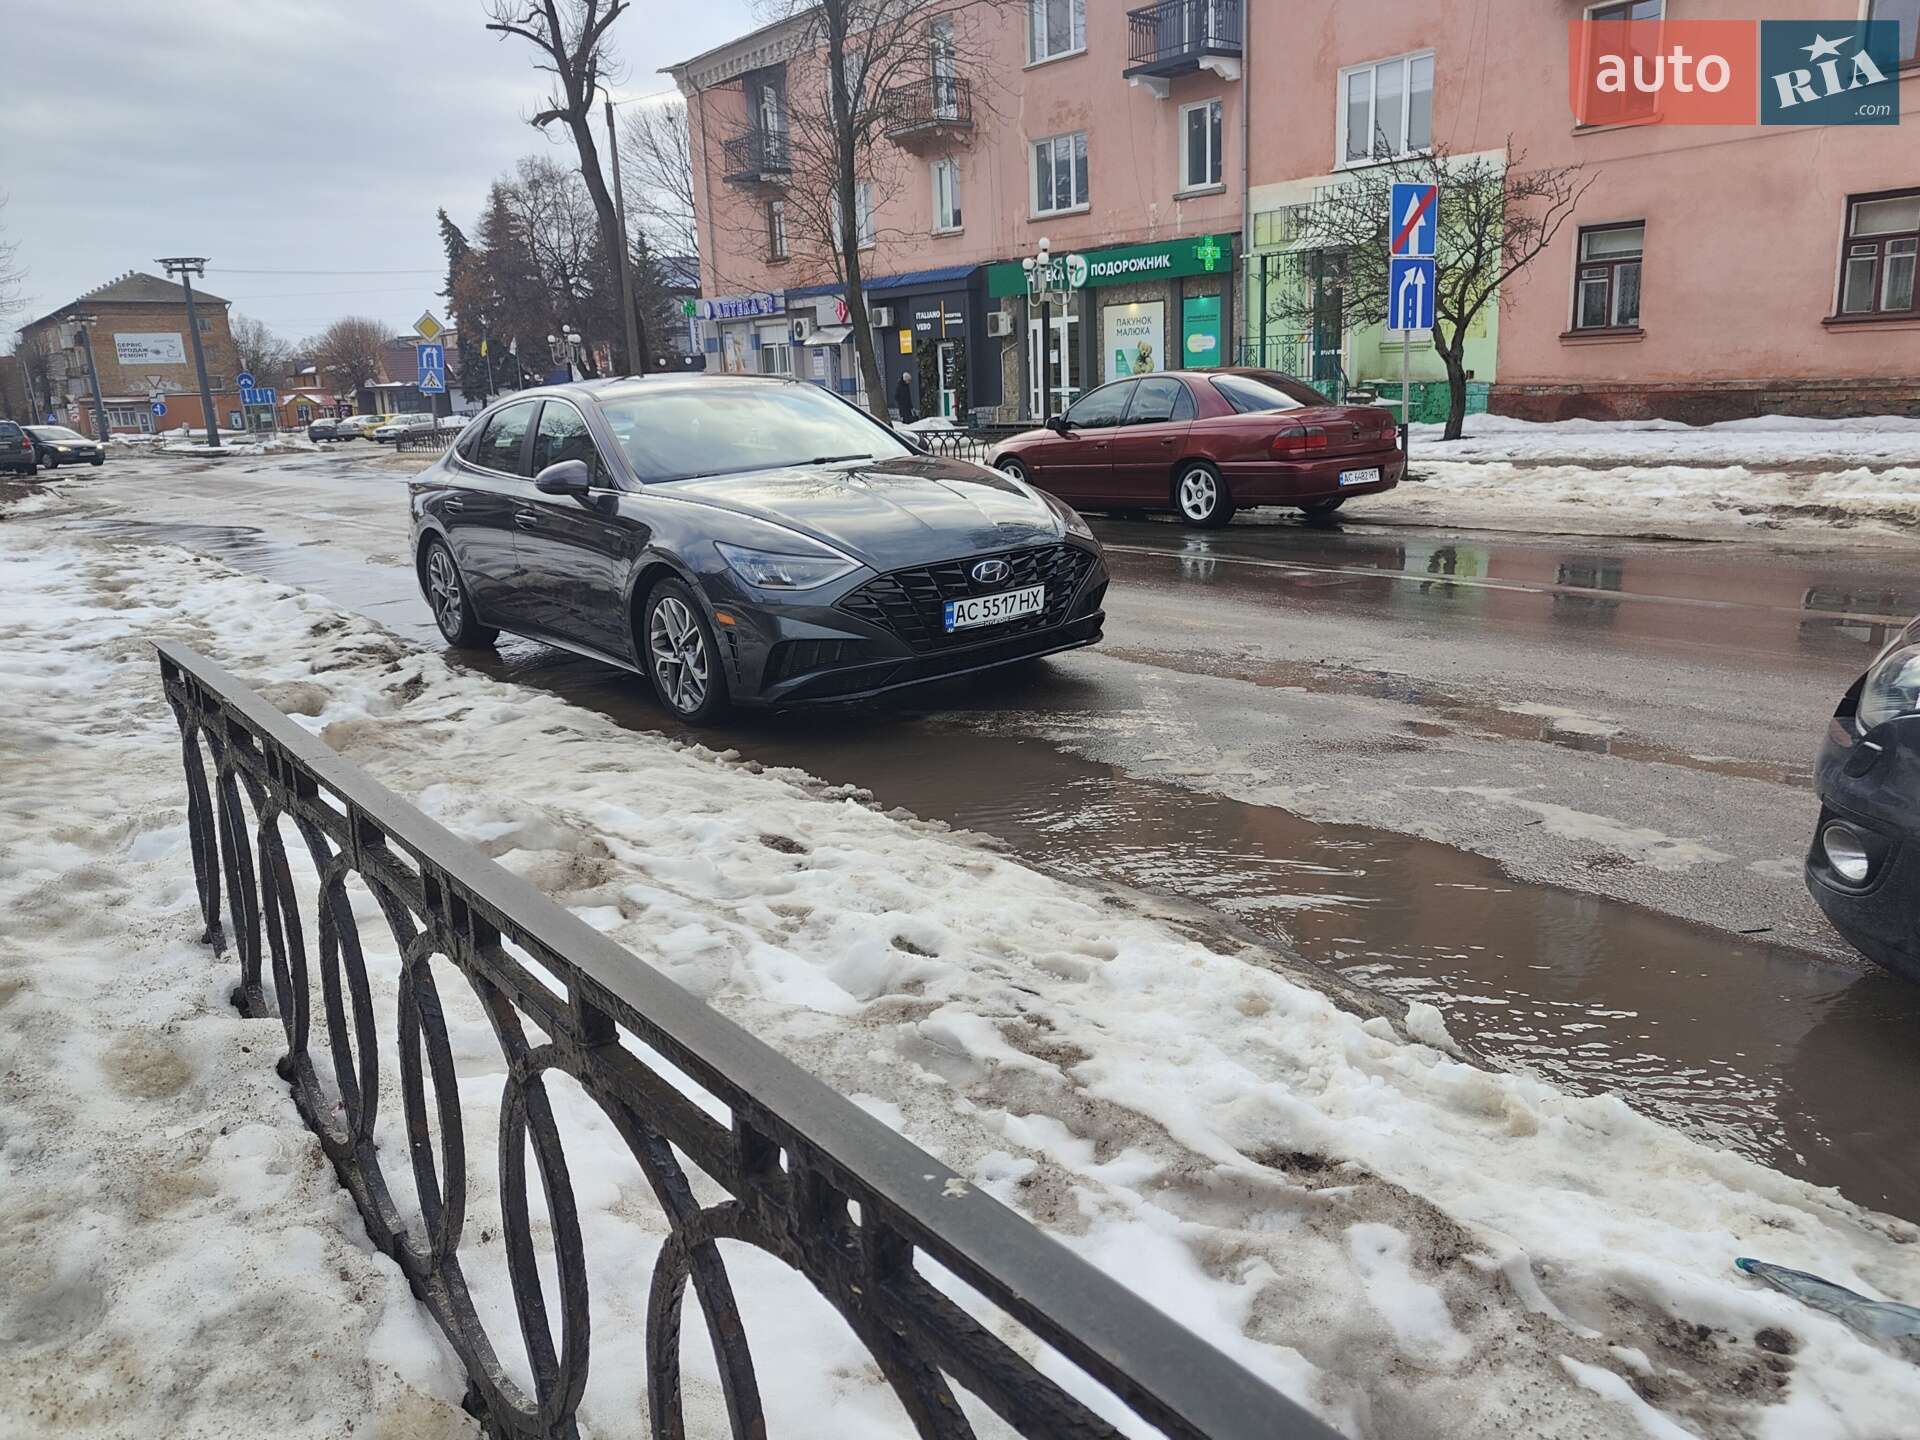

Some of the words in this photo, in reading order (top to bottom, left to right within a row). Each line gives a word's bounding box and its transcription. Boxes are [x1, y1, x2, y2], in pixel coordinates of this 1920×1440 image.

[1090, 254, 1171, 277] ПОДОРОЖНИК
[915, 310, 940, 320] ITALIANO
[1116, 316, 1152, 327] ПАКУНОК
[1116, 327, 1151, 336] МАЛЮКА
[955, 602, 978, 623] AC
[982, 595, 1017, 618] 5517
[1020, 589, 1040, 611] HX
